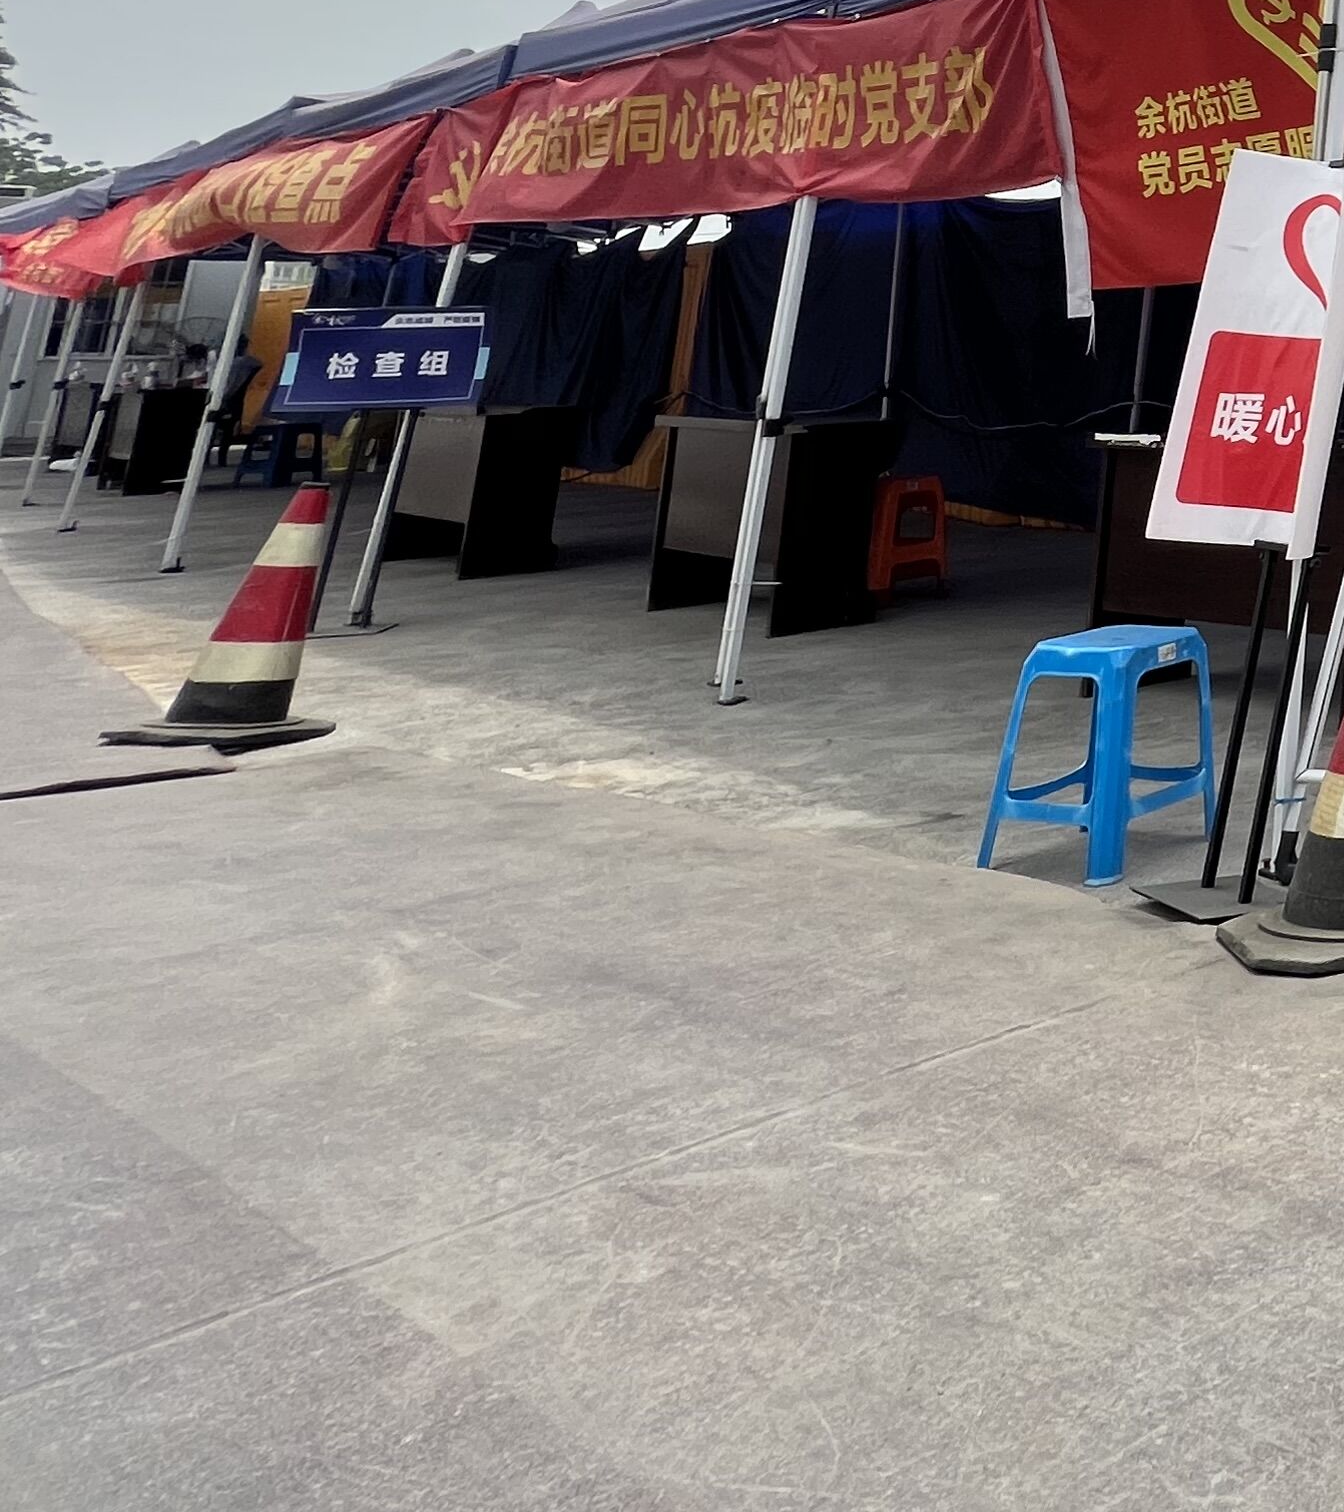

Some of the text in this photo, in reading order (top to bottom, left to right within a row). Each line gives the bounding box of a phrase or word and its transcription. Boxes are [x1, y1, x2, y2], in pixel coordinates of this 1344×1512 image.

[1134, 76, 1262, 139] 余杭街道
[325, 350, 450, 380] 检查组
[1209, 392, 1304, 446] 暖心
